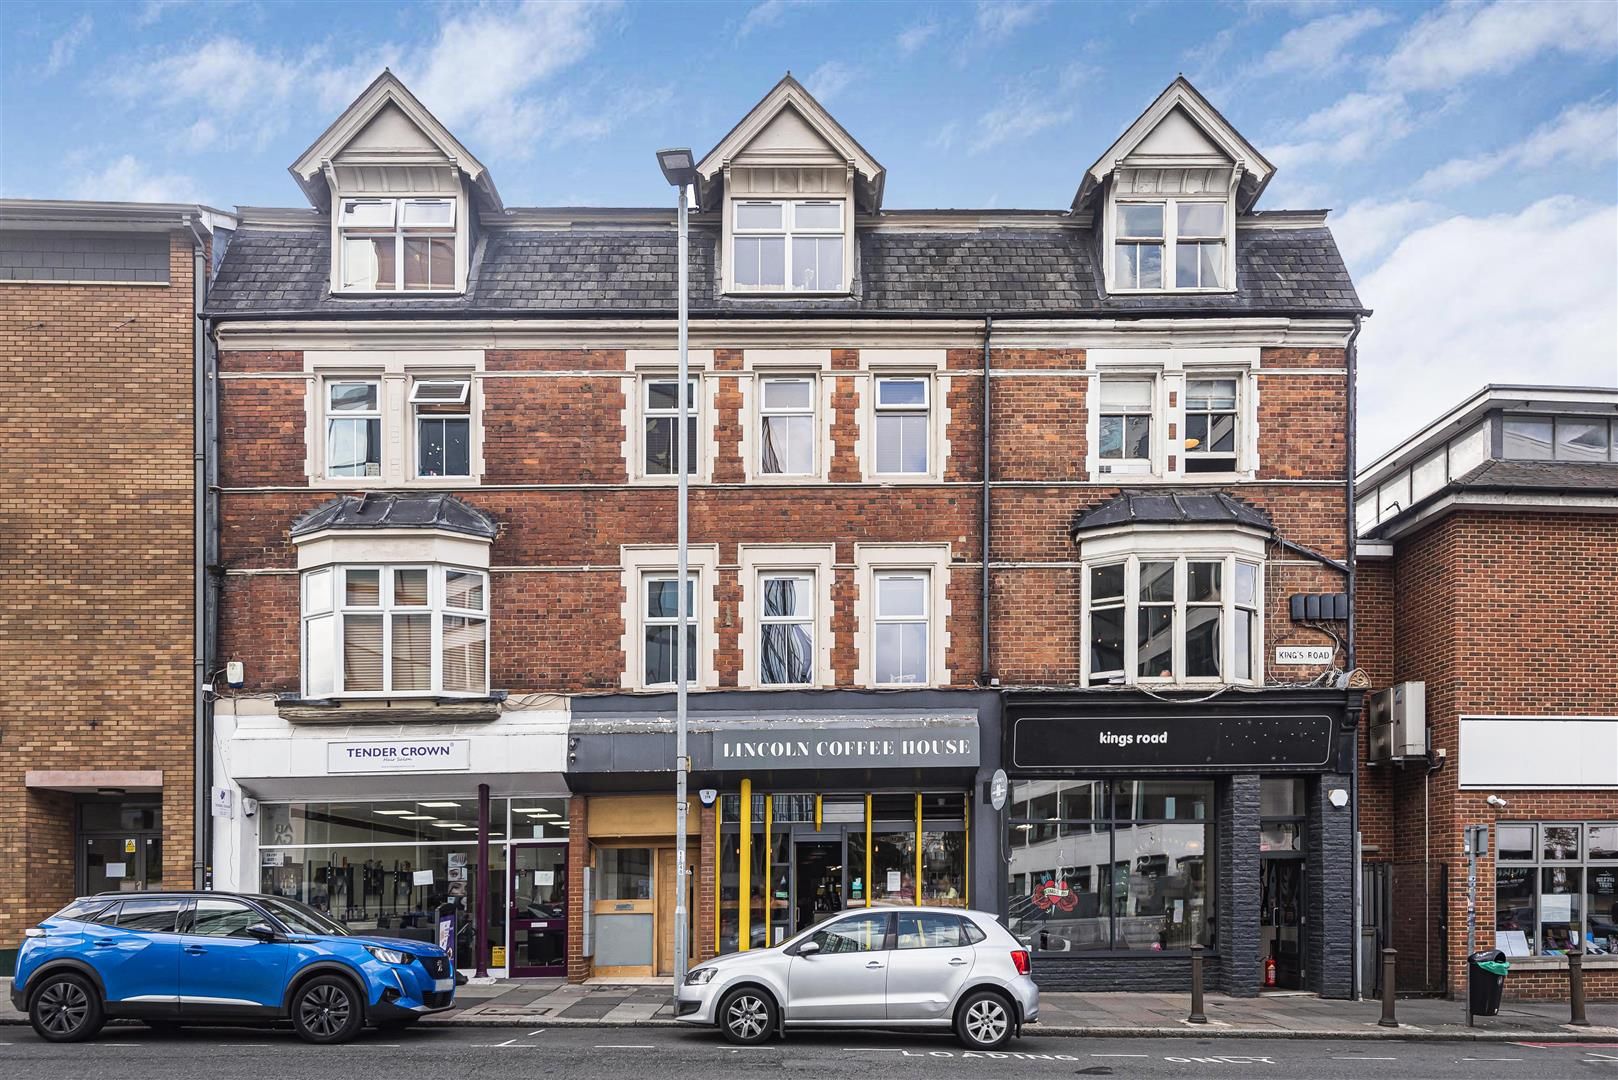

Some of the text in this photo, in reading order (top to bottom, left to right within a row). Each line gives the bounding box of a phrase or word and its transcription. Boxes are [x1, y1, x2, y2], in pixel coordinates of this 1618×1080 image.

[1279, 651, 1330, 660] KING'S ROAD
[1099, 731, 1168, 747] kings road
[346, 746, 450, 757] TENDER CROWN
[723, 739, 971, 757] LINCOLN COFFEE HOUSE
[901, 1050, 1275, 1064] LOADING ONLY
